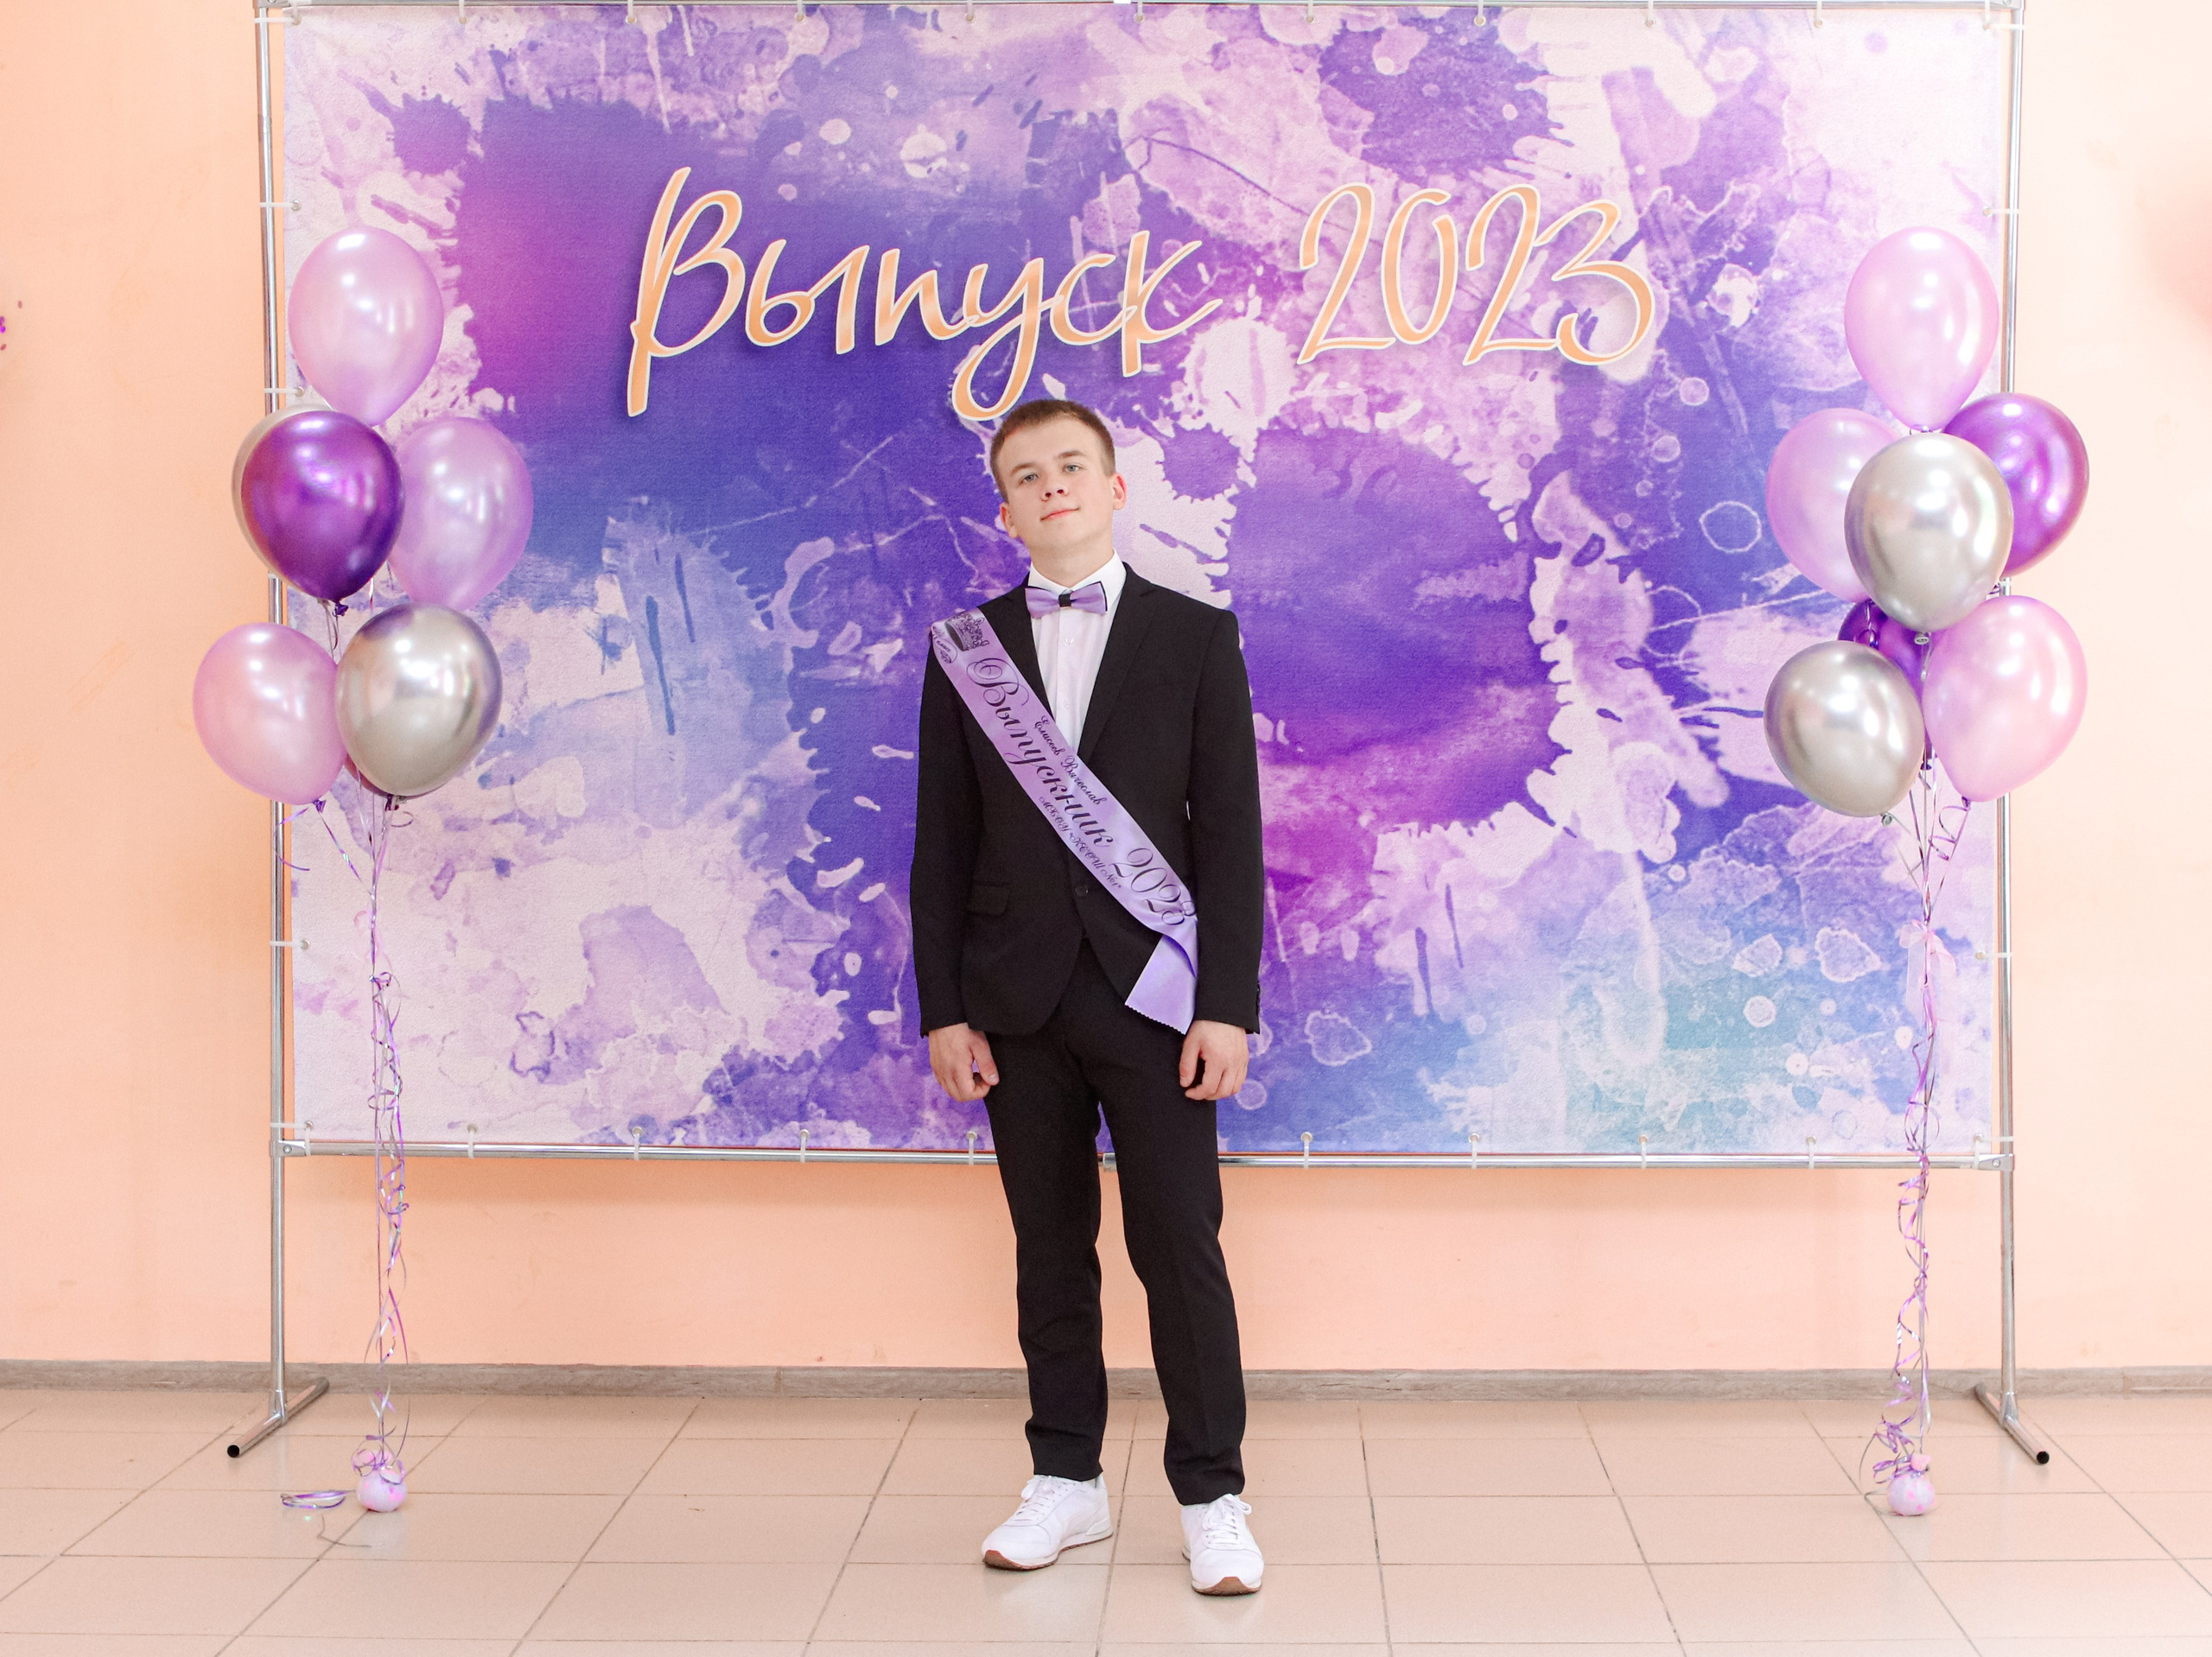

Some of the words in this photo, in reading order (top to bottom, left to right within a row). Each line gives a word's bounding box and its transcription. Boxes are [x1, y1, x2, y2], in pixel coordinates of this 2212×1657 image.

[627, 167, 1223, 421] Выпуск
[1297, 182, 1656, 365] 2023
[966, 657, 1114, 848] Выпускник
[1034, 715, 1065, 756] Елисеев
[1060, 755, 1107, 805] Вячеслав
